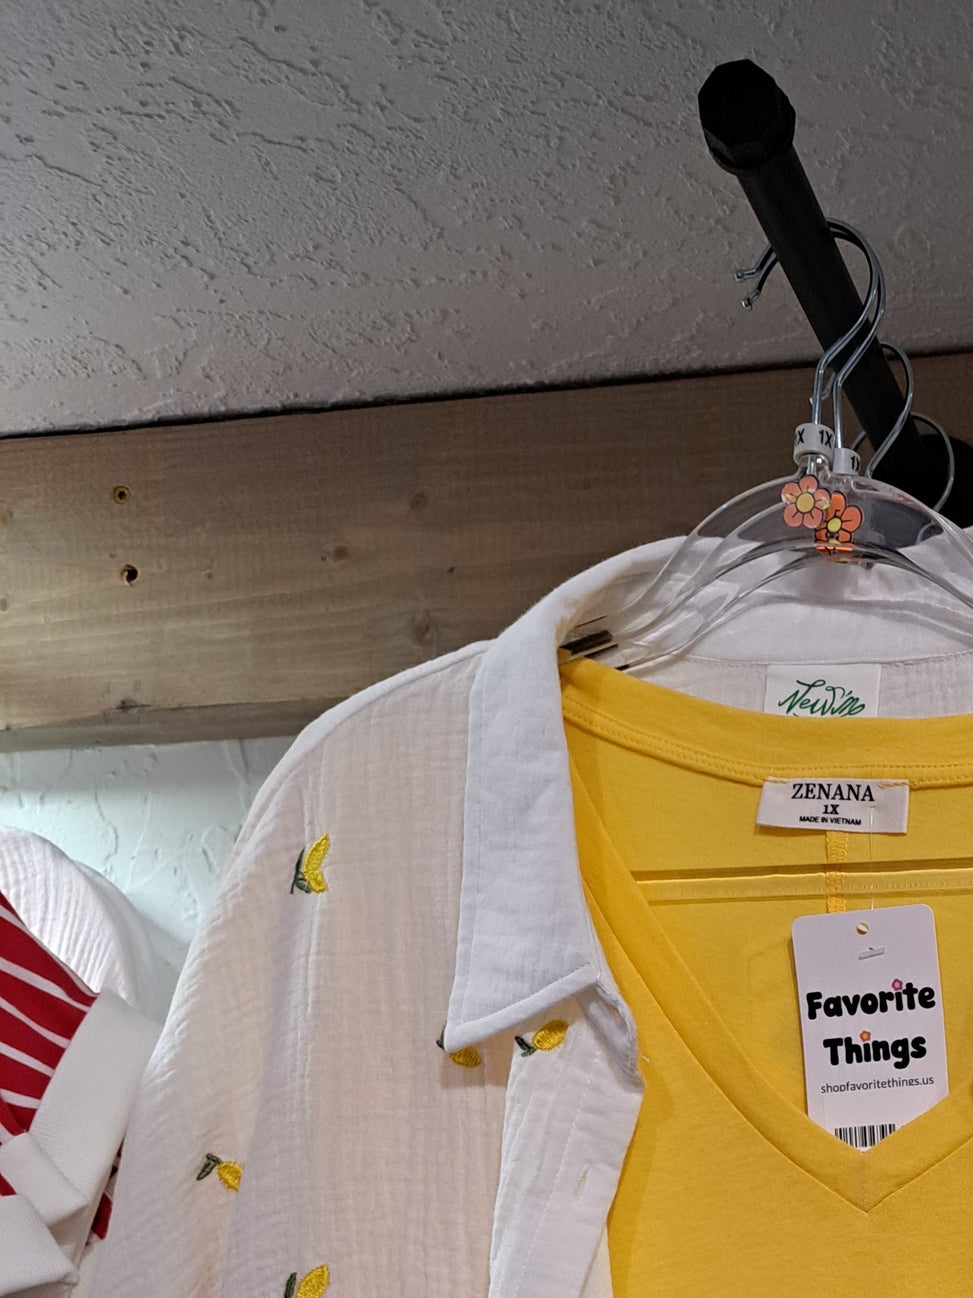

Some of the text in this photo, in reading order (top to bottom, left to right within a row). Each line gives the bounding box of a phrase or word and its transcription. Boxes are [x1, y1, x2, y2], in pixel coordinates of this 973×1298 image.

[819, 428, 833, 449] 1X
[791, 783, 875, 802] ZENANA
[822, 804, 840, 815] 1X
[799, 815, 862, 826] MADE IN VIETNAM
[806, 980, 936, 1020] Favorite
[823, 1031, 927, 1069] Things
[821, 1077, 935, 1094] shopfavoritethings.us
